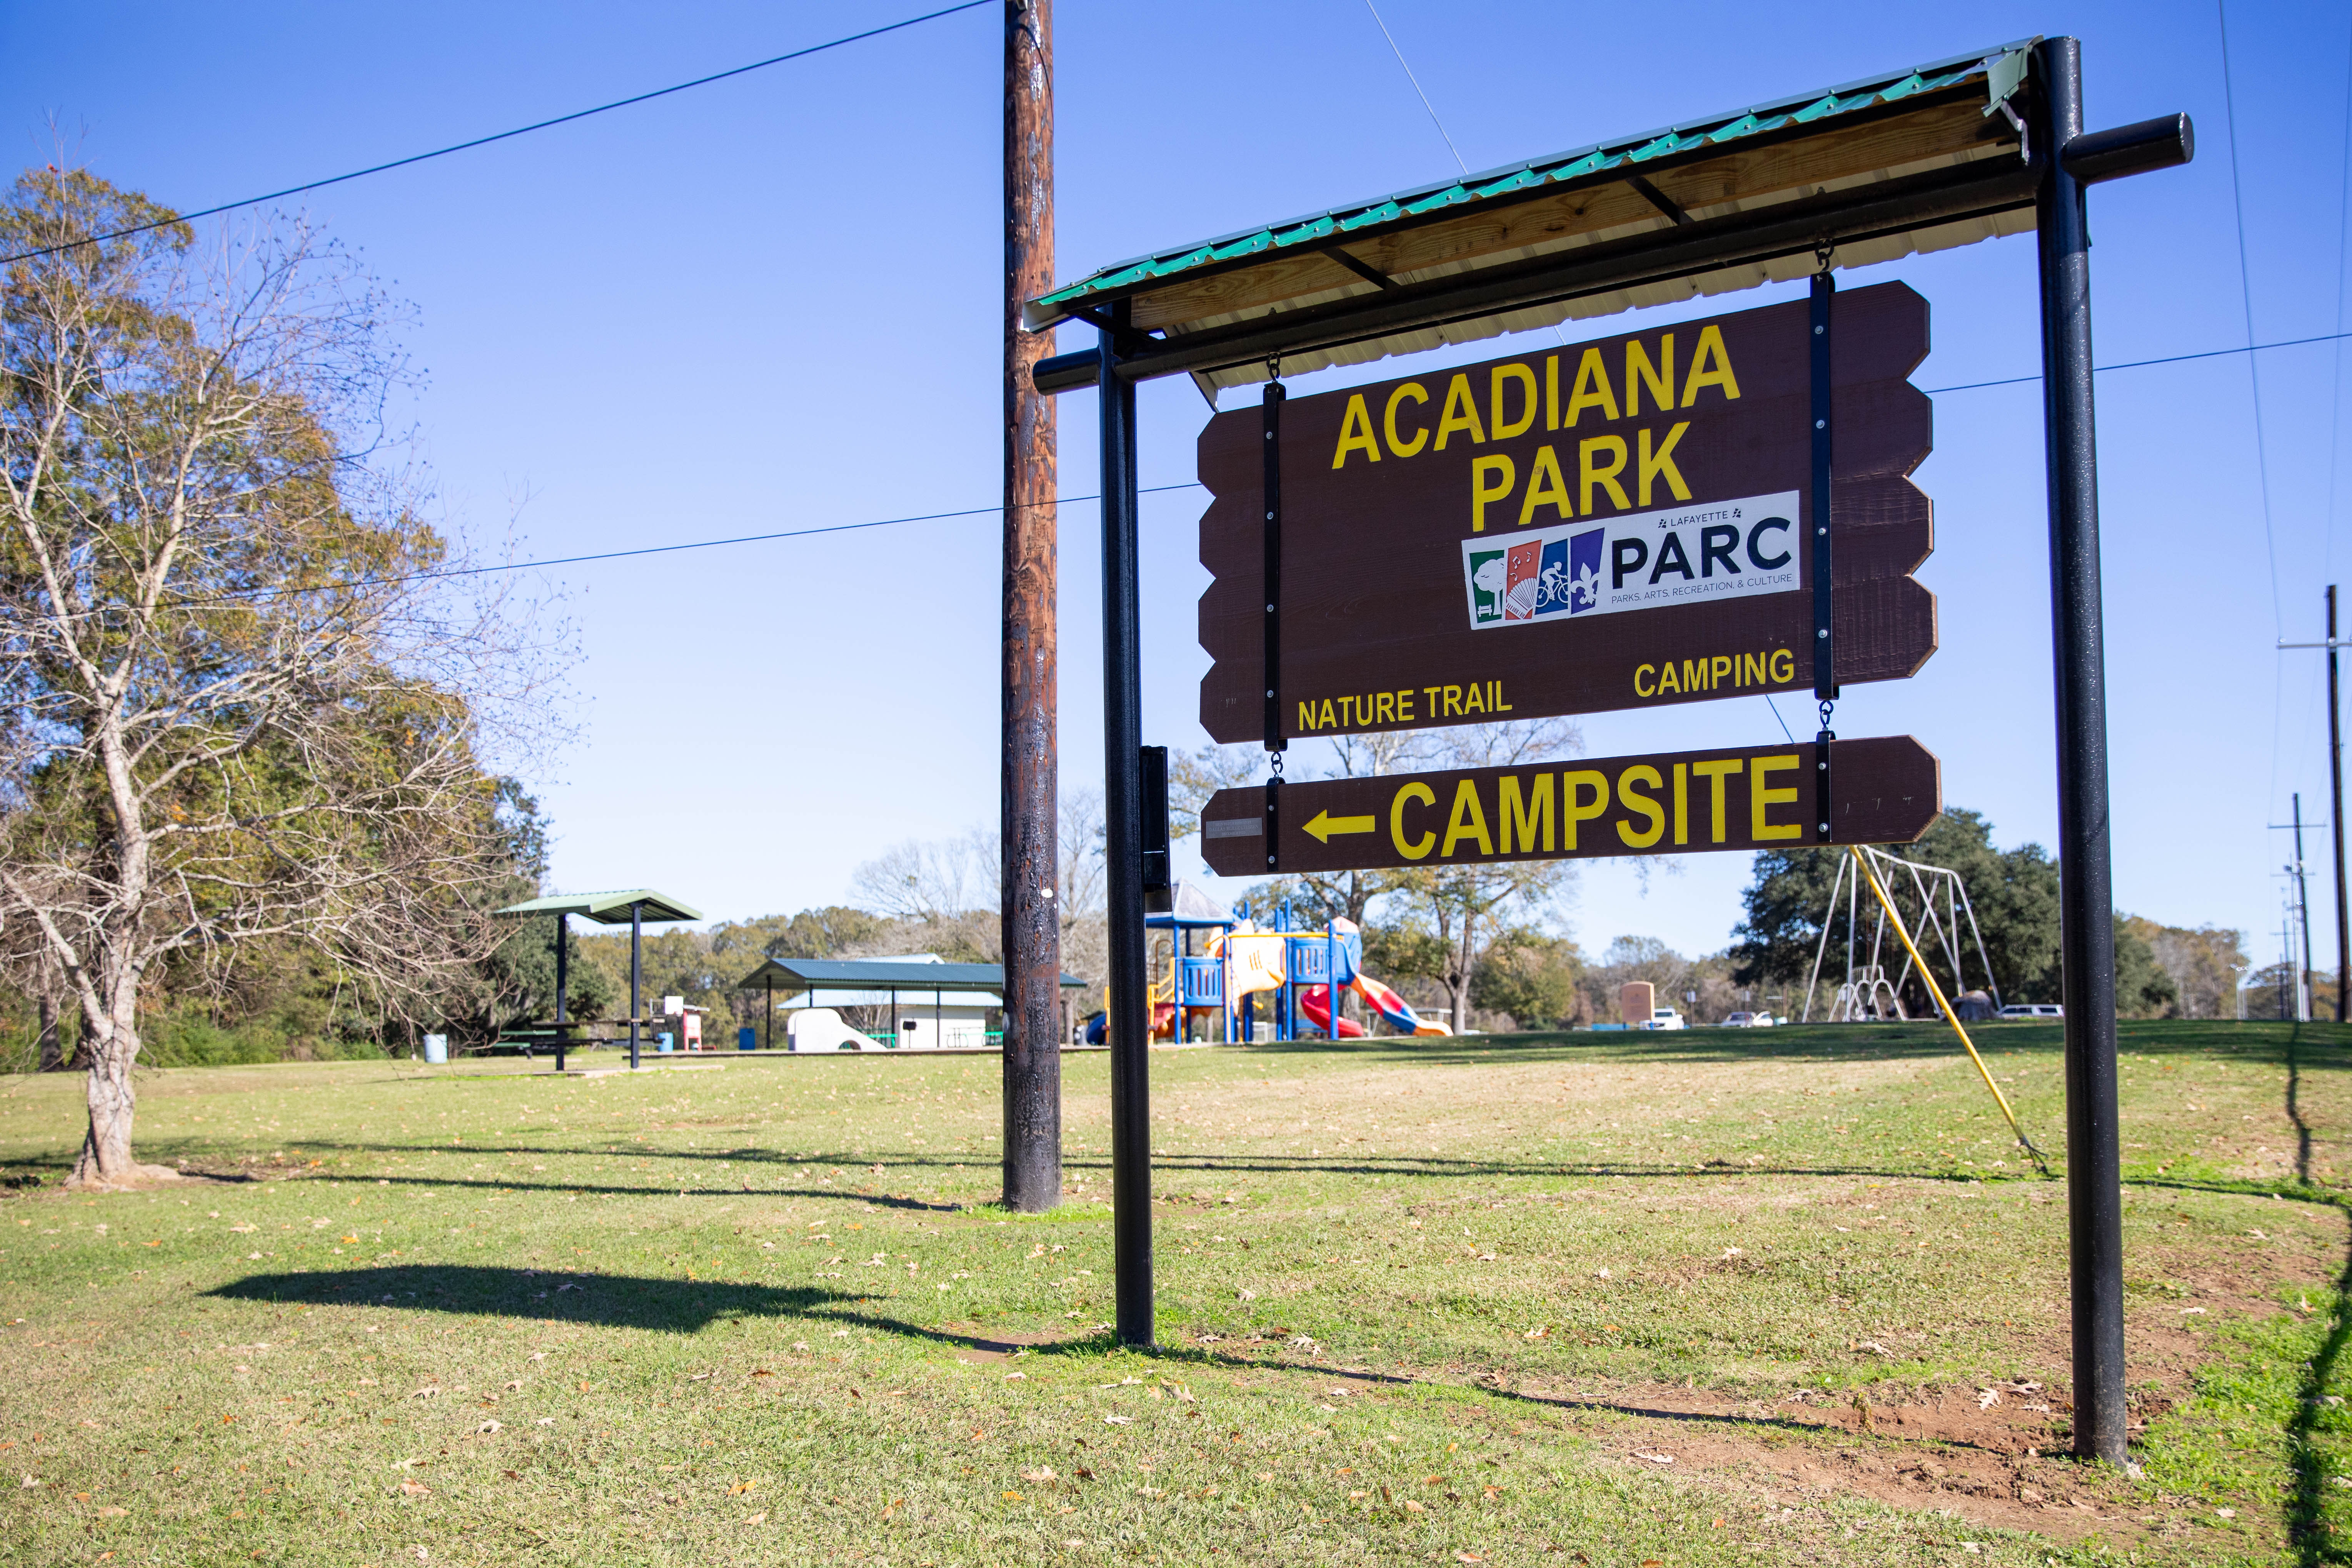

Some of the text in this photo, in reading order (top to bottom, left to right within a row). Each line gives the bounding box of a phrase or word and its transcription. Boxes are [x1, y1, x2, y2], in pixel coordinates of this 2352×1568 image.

[1333, 325, 1740, 469] ACADIANA
[1473, 422, 1692, 531] PARK
[1671, 511, 1728, 527] LAFAYETTE
[1612, 517, 1792, 590] PARC
[1737, 580, 1744, 588] &
[1747, 573, 1792, 587] CULTURE
[1635, 649, 1794, 697] CAMPING
[1299, 681, 1512, 731] NATURE TRAIL
[1390, 754, 1802, 860] CAMPSITE
